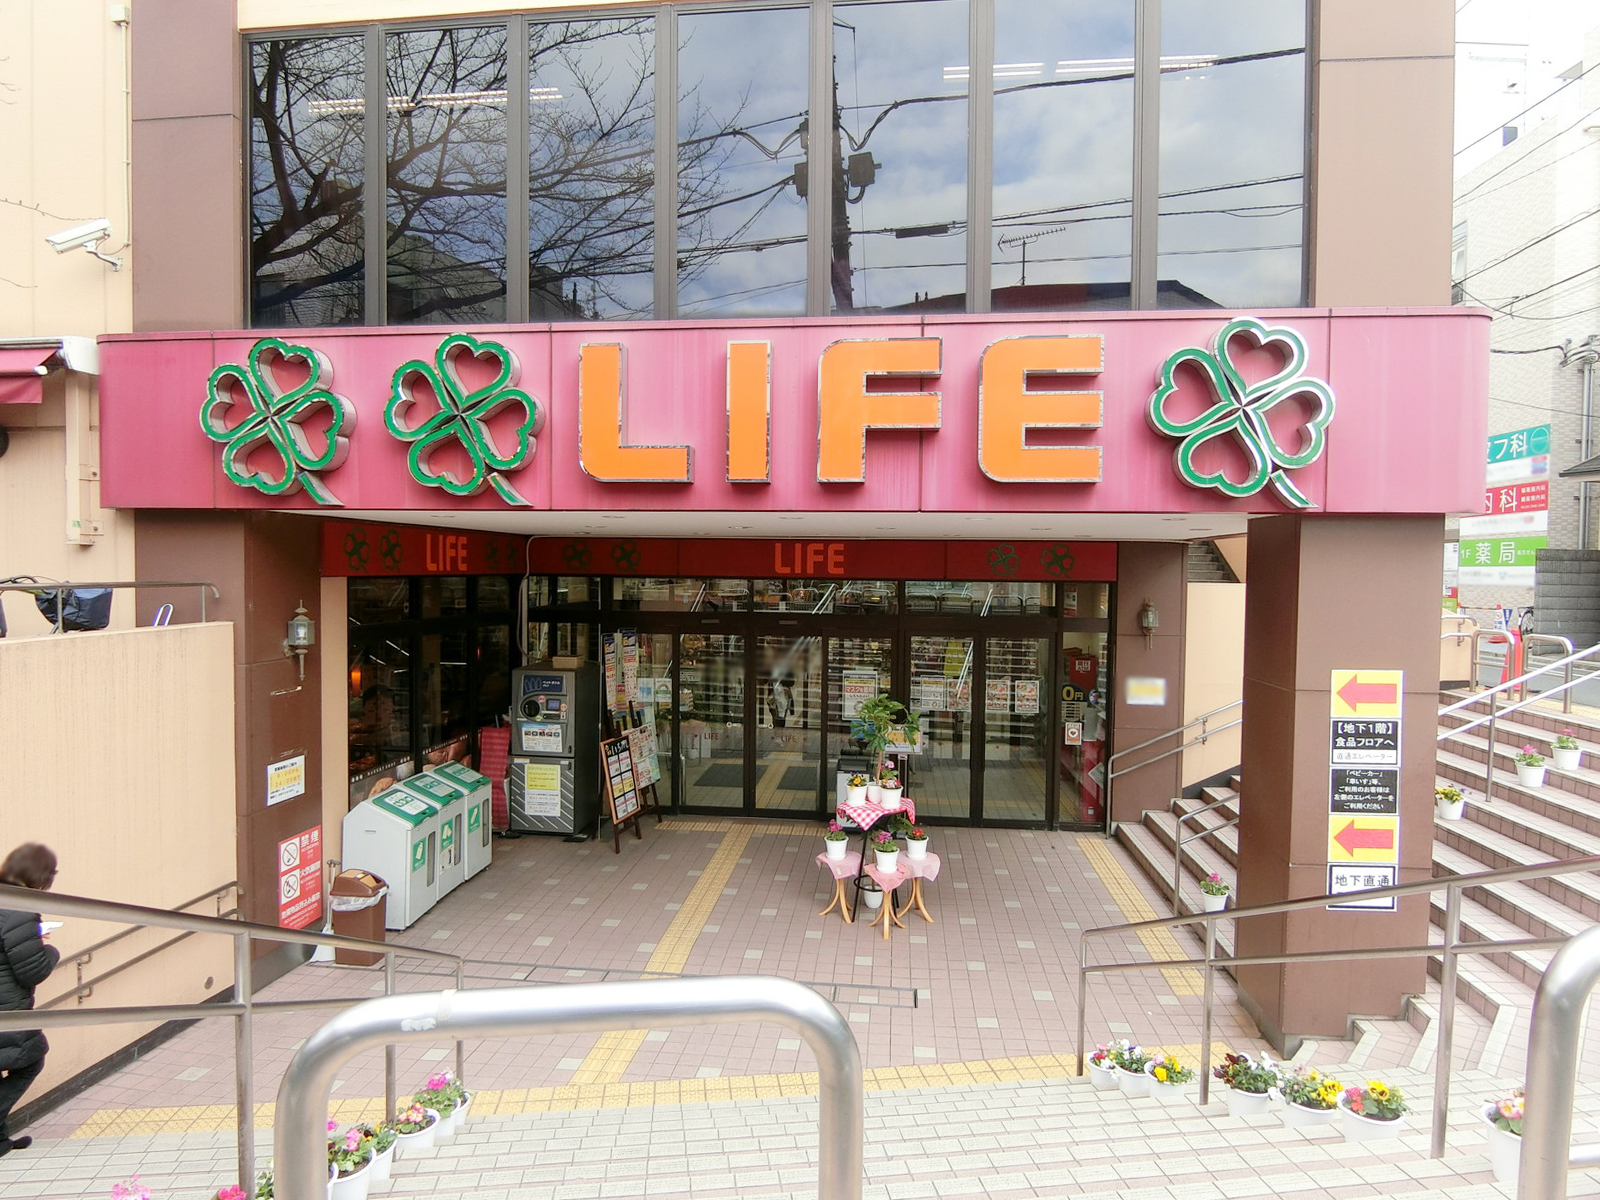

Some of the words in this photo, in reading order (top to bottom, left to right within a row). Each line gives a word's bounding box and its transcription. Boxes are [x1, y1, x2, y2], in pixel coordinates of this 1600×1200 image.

[578, 334, 1105, 483] LIFE
[426, 533, 468, 572] LIFE
[774, 542, 844, 574] LIFE
[1460, 549, 1471, 559] 1F
[1475, 541, 1515, 564] 薬局
[1337, 722, 1393, 735] 【地下1階】
[704, 732, 719, 740] LIFE
[781, 735, 796, 743] LIFE
[1335, 736, 1395, 748] 食品フロアへ
[1336, 752, 1393, 760] 直通エレベーター
[1335, 874, 1389, 887] 地下直通
